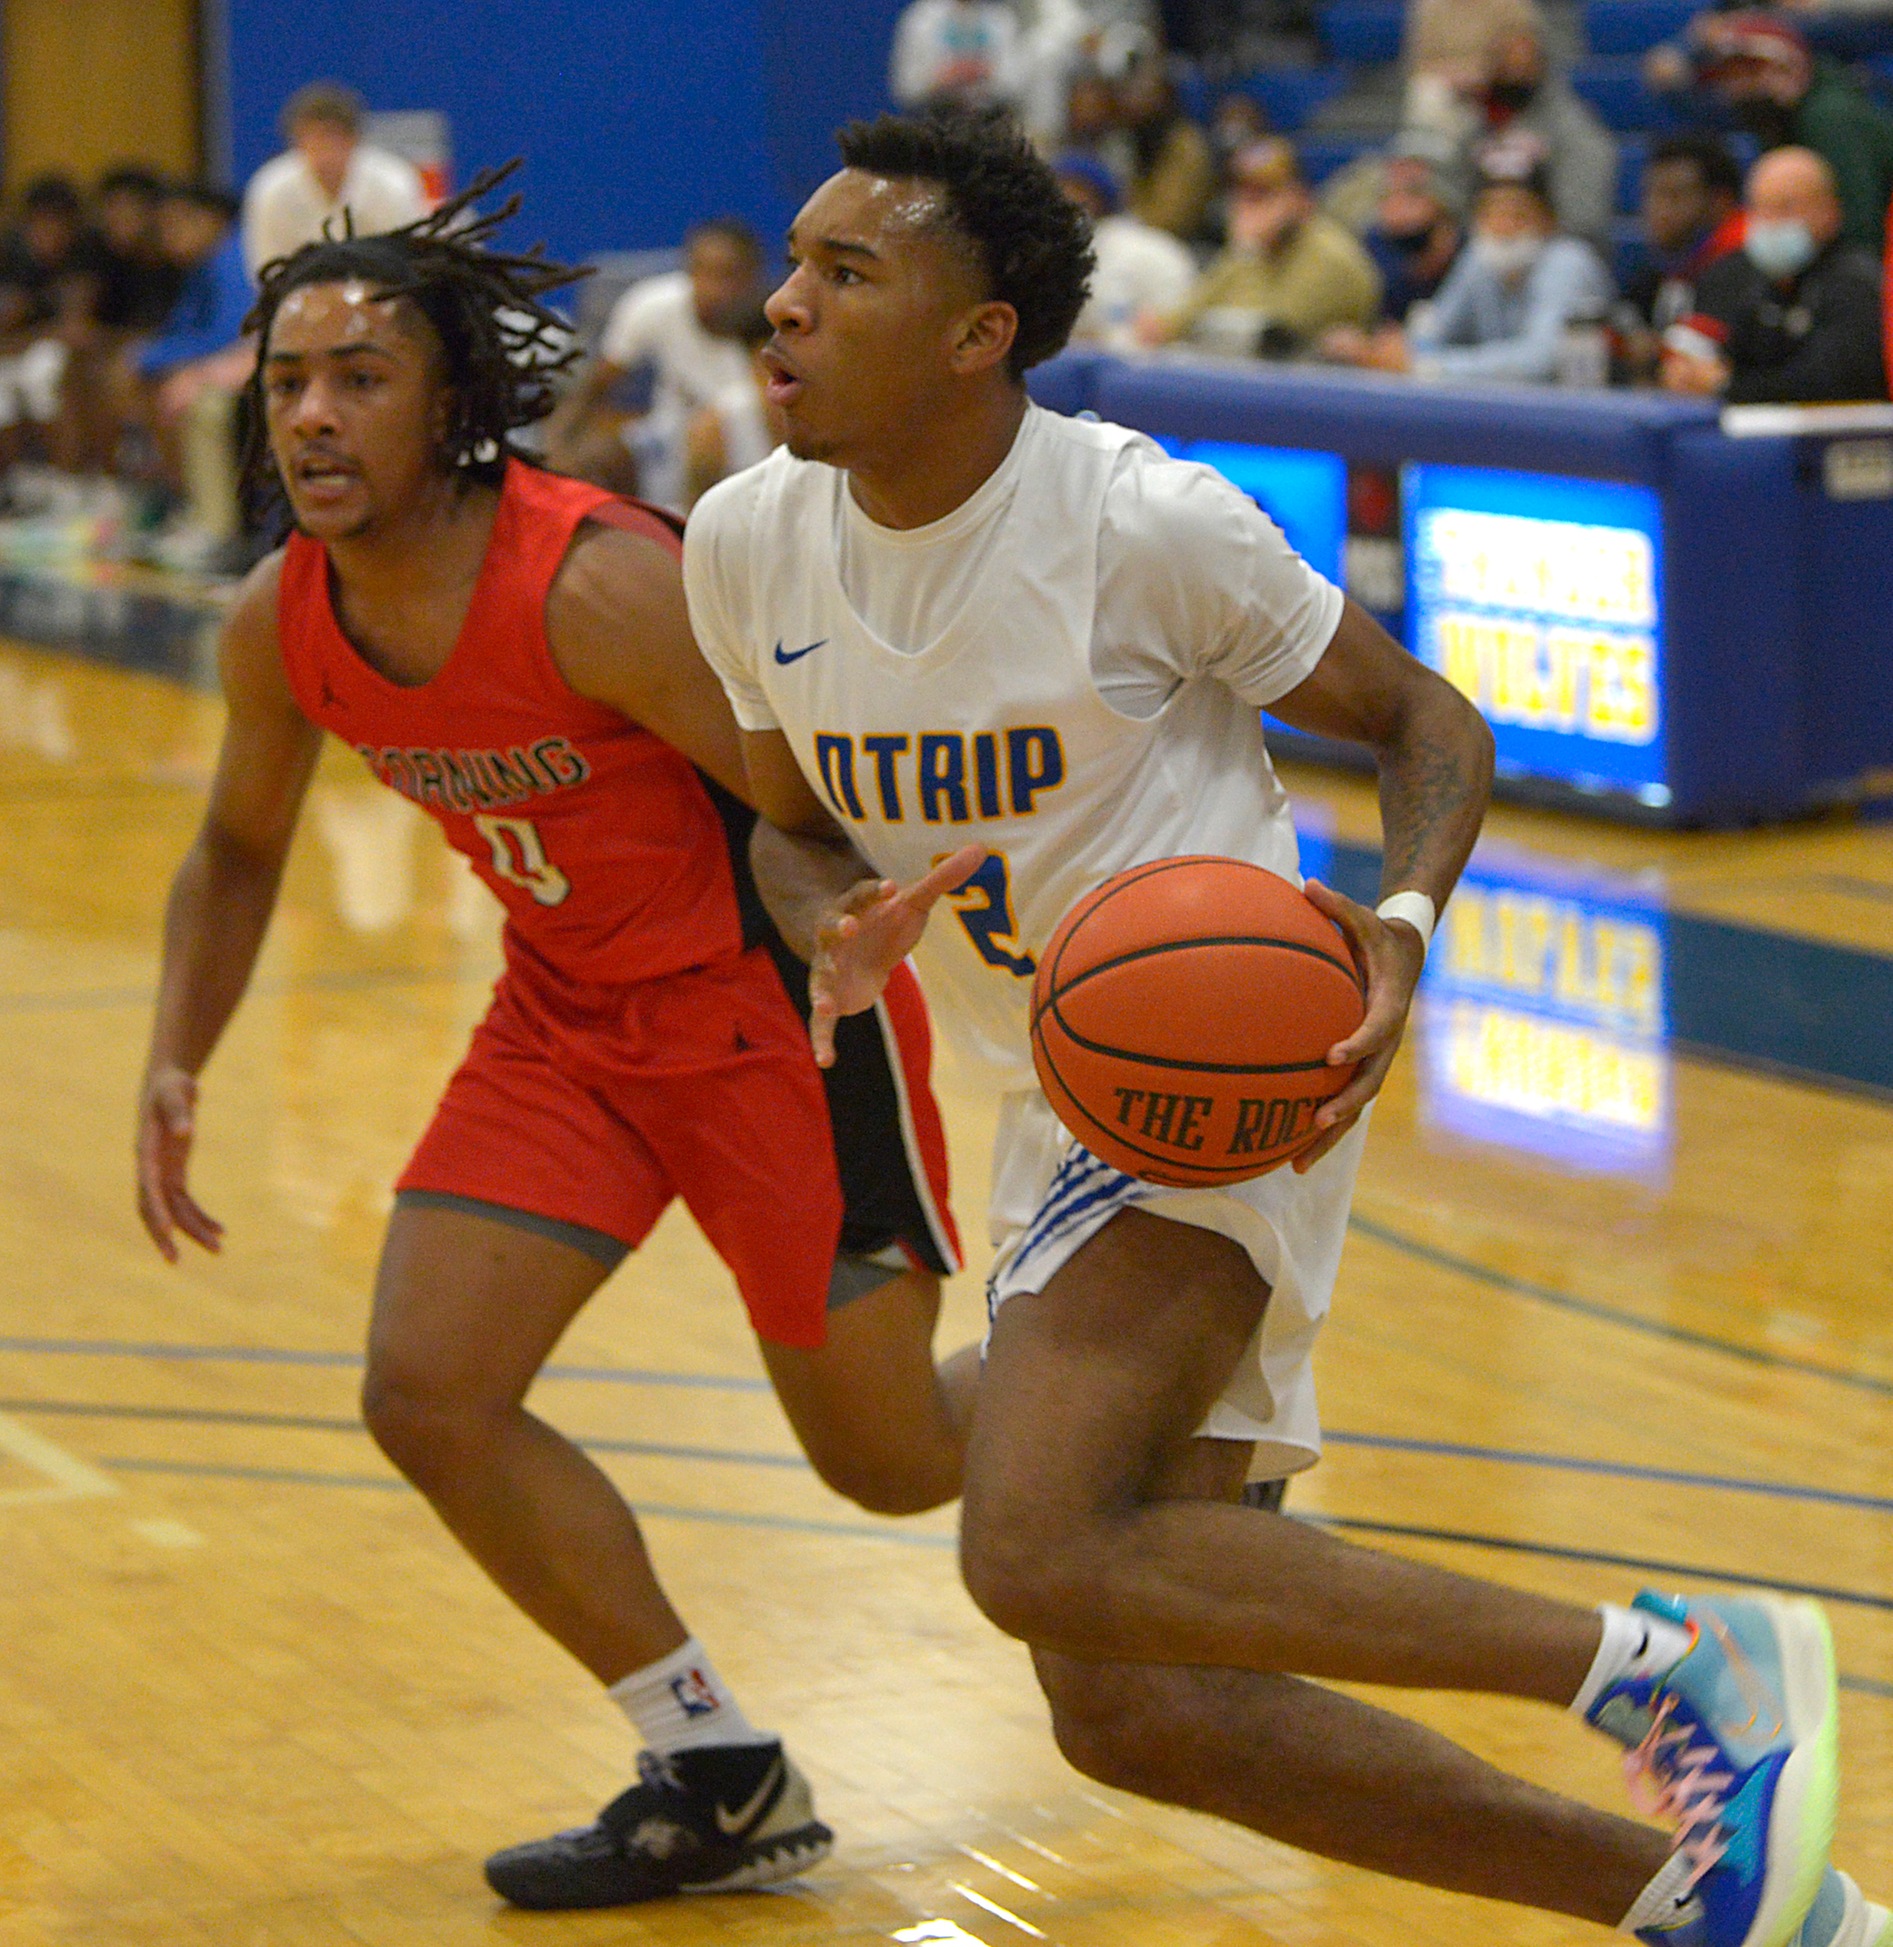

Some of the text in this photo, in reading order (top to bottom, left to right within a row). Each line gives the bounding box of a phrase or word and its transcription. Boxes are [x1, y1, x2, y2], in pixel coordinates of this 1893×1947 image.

[472, 813, 571, 906] 0
[931, 848, 1038, 978] 2
[1115, 1087, 1213, 1151] THE
